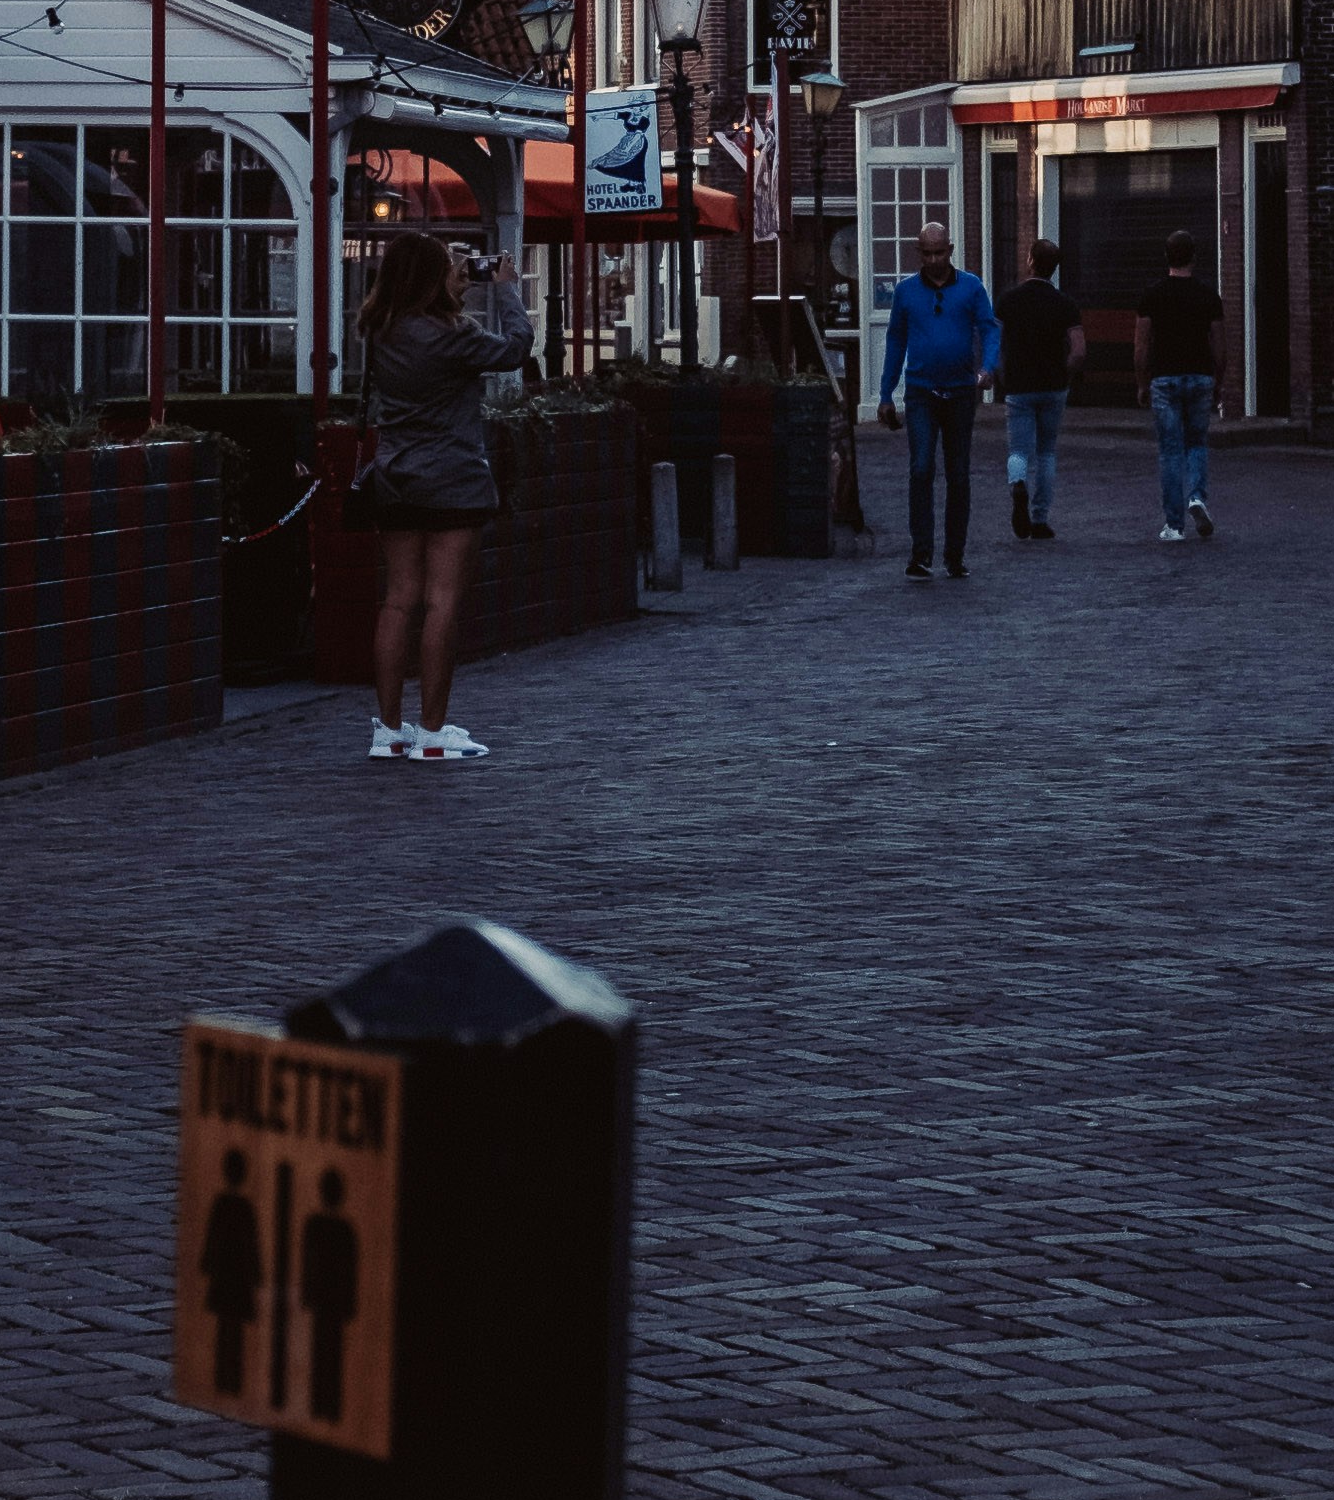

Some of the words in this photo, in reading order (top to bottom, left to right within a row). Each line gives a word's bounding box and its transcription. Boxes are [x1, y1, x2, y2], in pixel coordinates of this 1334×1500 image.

[586, 182, 621, 196] HOTEL
[587, 194, 658, 211] SPAANDER
[196, 1037, 390, 1152] TOILETTEN
